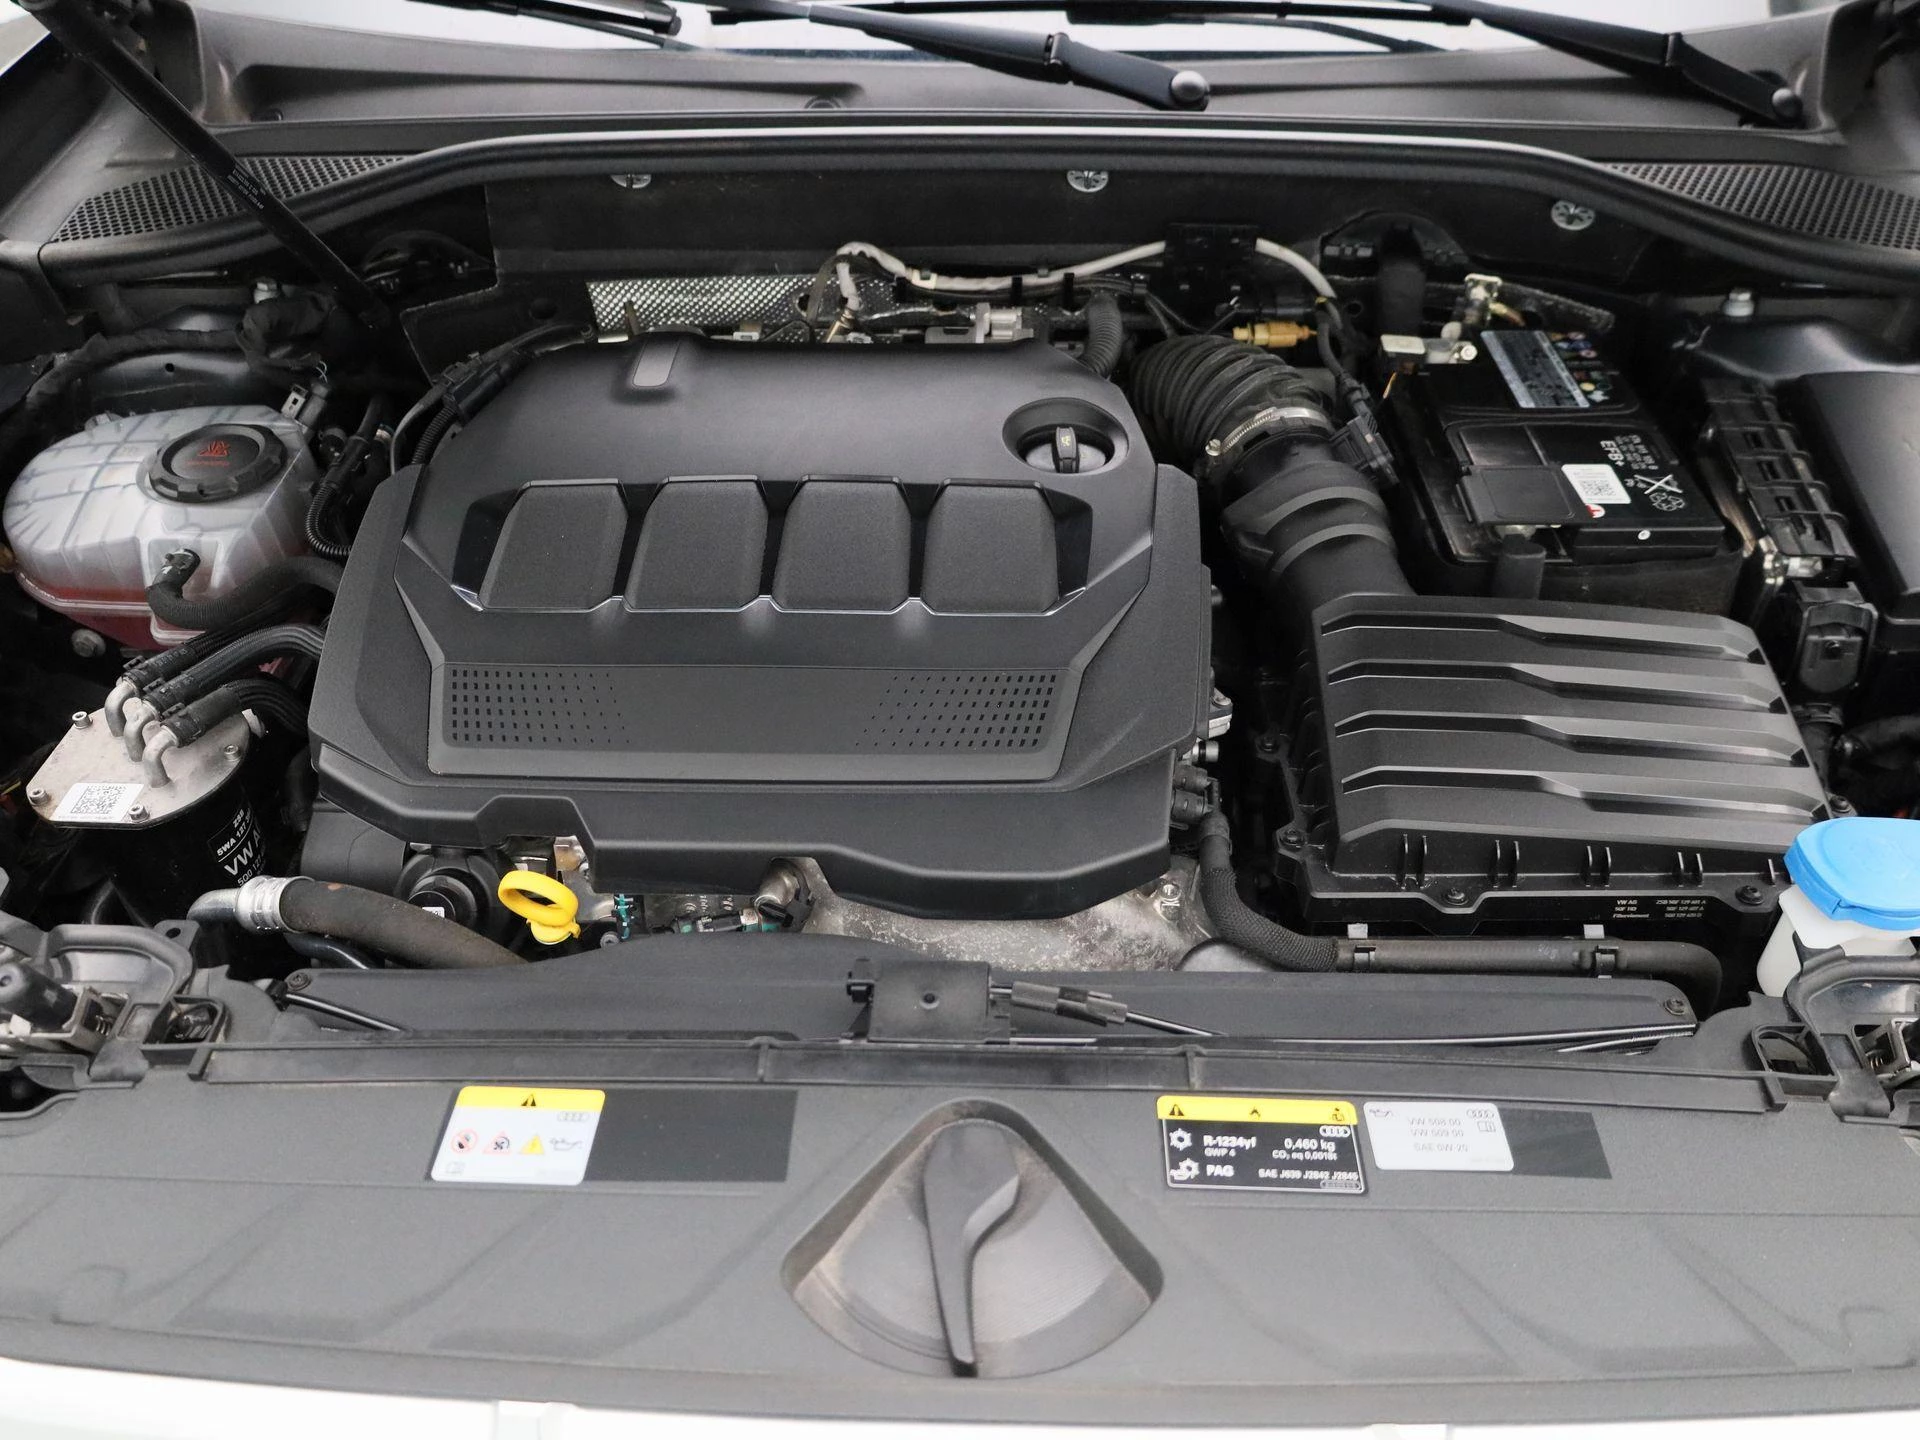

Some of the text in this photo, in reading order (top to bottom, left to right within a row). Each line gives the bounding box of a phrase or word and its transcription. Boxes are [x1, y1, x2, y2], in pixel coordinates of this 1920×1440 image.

[223, 840, 254, 876] VW
[1408, 1117, 1425, 1126] VW
[1448, 1118, 1462, 1126] 00
[1203, 1135, 1257, 1150] R-1234yf
[1320, 1138, 1336, 1152] kg
[1204, 1149, 1228, 1157] GWP
[1206, 1164, 1235, 1177] PAG
[1258, 1168, 1279, 1179] SAE
